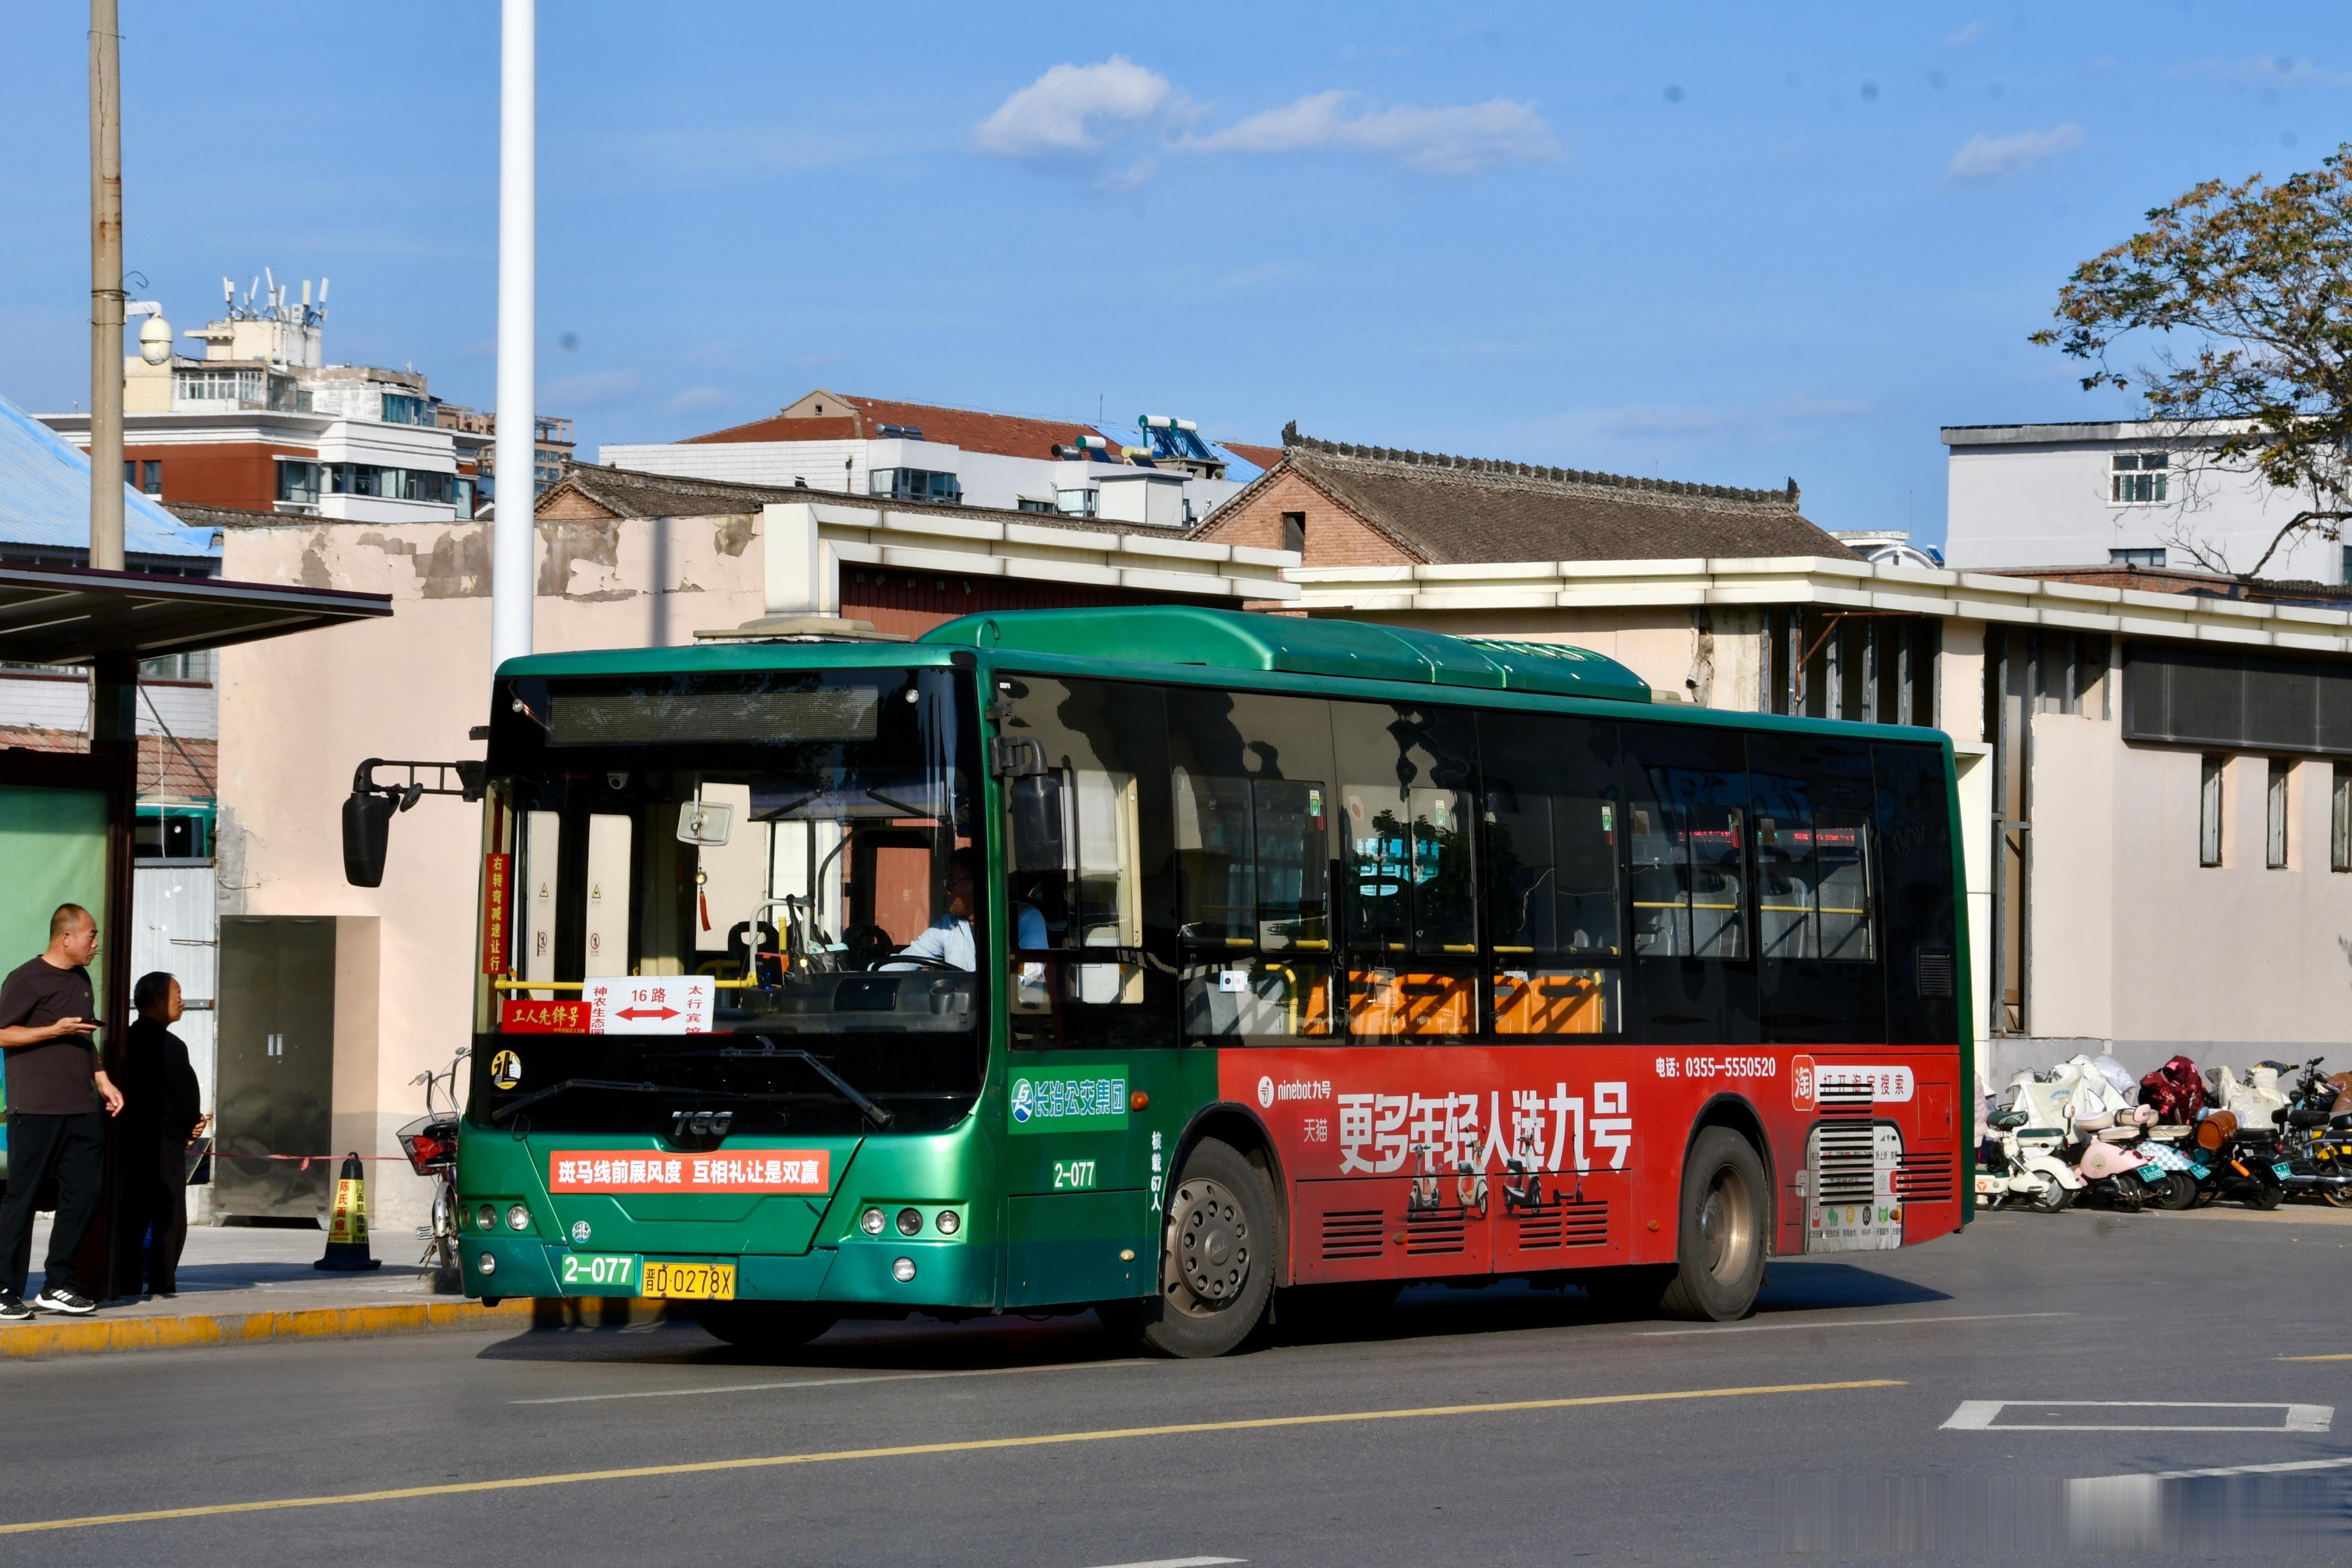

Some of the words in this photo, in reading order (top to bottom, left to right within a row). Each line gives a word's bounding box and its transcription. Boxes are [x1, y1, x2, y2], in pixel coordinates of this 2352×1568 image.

[490, 856, 502, 971] 右转弯减速让行
[512, 1005, 578, 1028] 工人先锋号
[1686, 1057, 1776, 1077] 0355-5550520
[1034, 1079, 1125, 1117] 长治公交集团
[1304, 1118, 1327, 1143] 天猫
[1337, 1081, 1633, 1177] 更多年轻人选九号
[558, 1159, 682, 1184] 斑马线前展风度
[692, 1159, 819, 1184] 互相礼让是双赢
[1054, 1161, 1095, 1188] 2-077
[1151, 1131, 1162, 1212] 核载67人
[565, 1257, 633, 1284] 2-077
